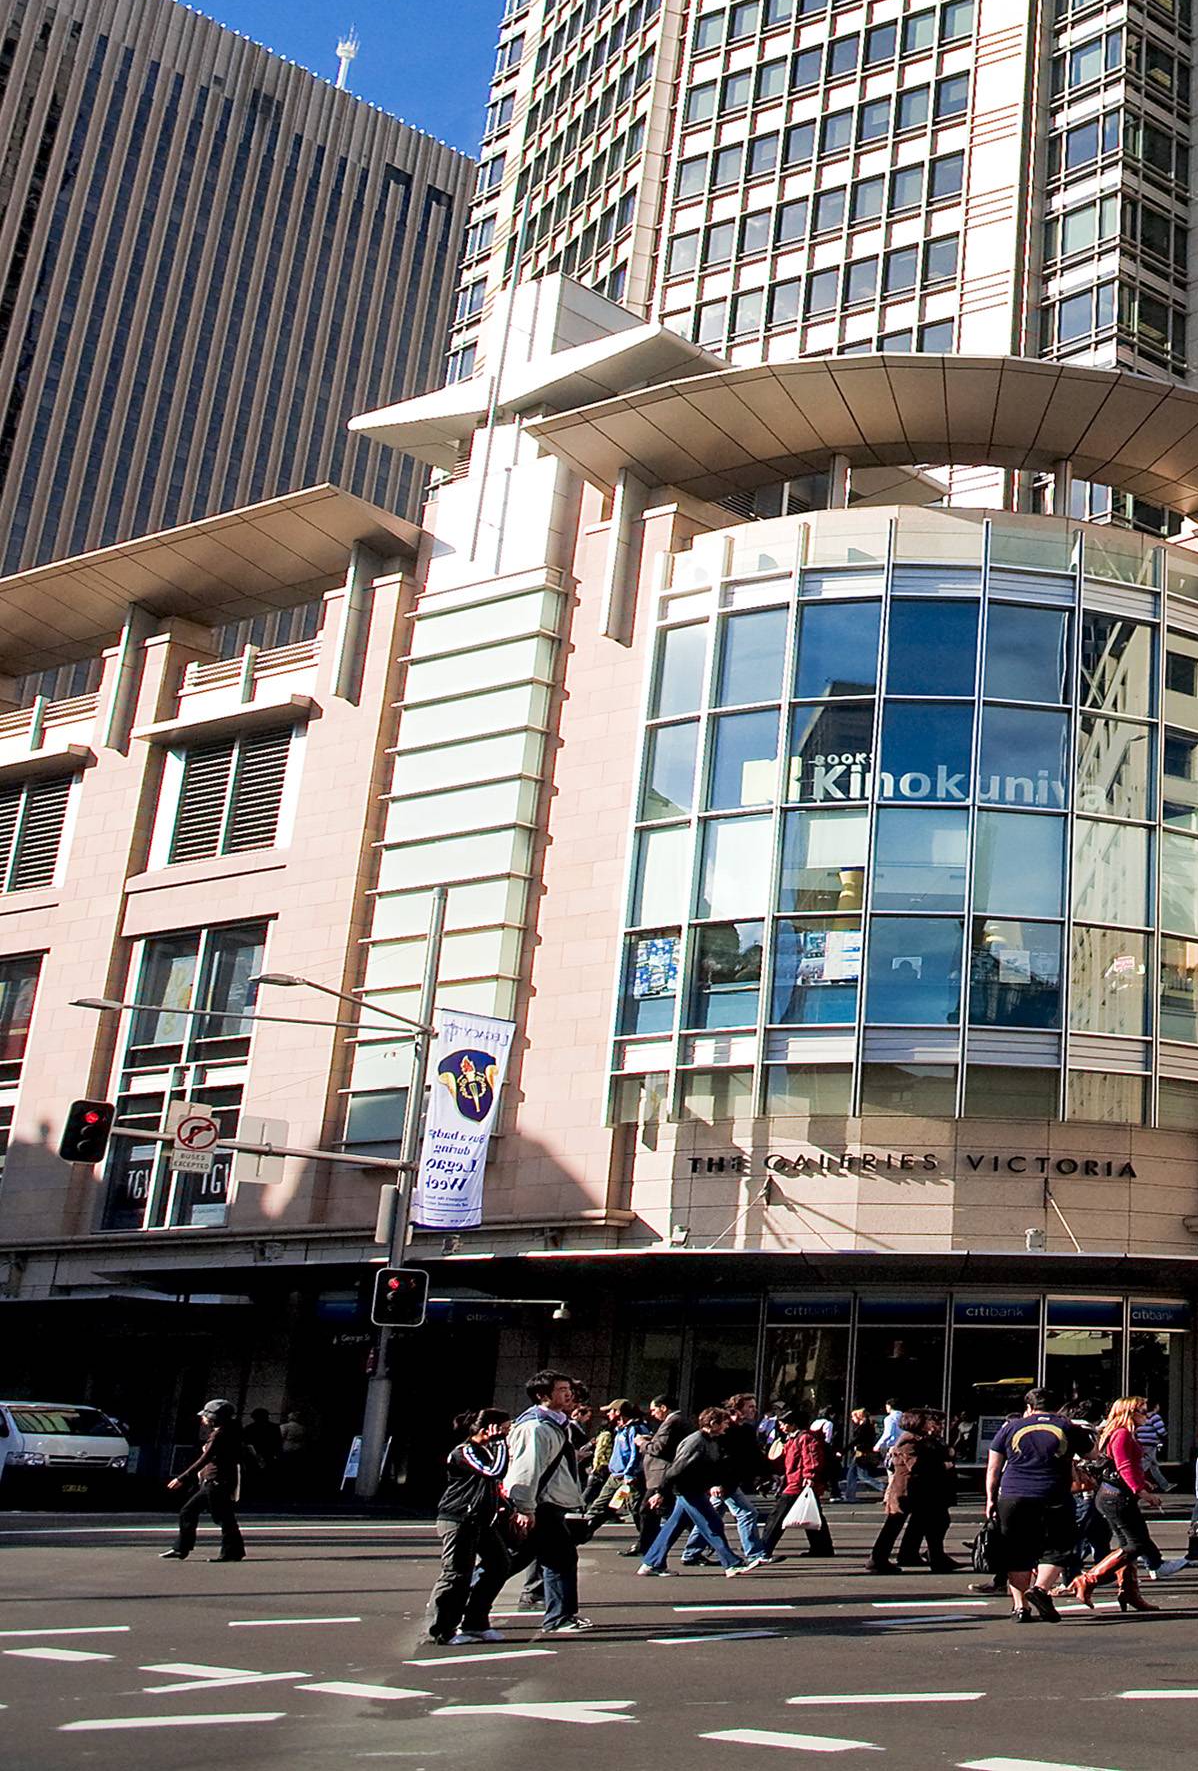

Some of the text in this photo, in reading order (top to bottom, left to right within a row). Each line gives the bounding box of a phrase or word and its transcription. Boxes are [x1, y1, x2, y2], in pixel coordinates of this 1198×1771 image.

[180, 1153, 206, 1161] BUSES
[173, 1160, 210, 1170] EXCEPTED
[688, 1153, 1137, 1178] THE GALERIES VICTORIA
[966, 1305, 1024, 1317] citibank
[1132, 1308, 1174, 1321] citibank
